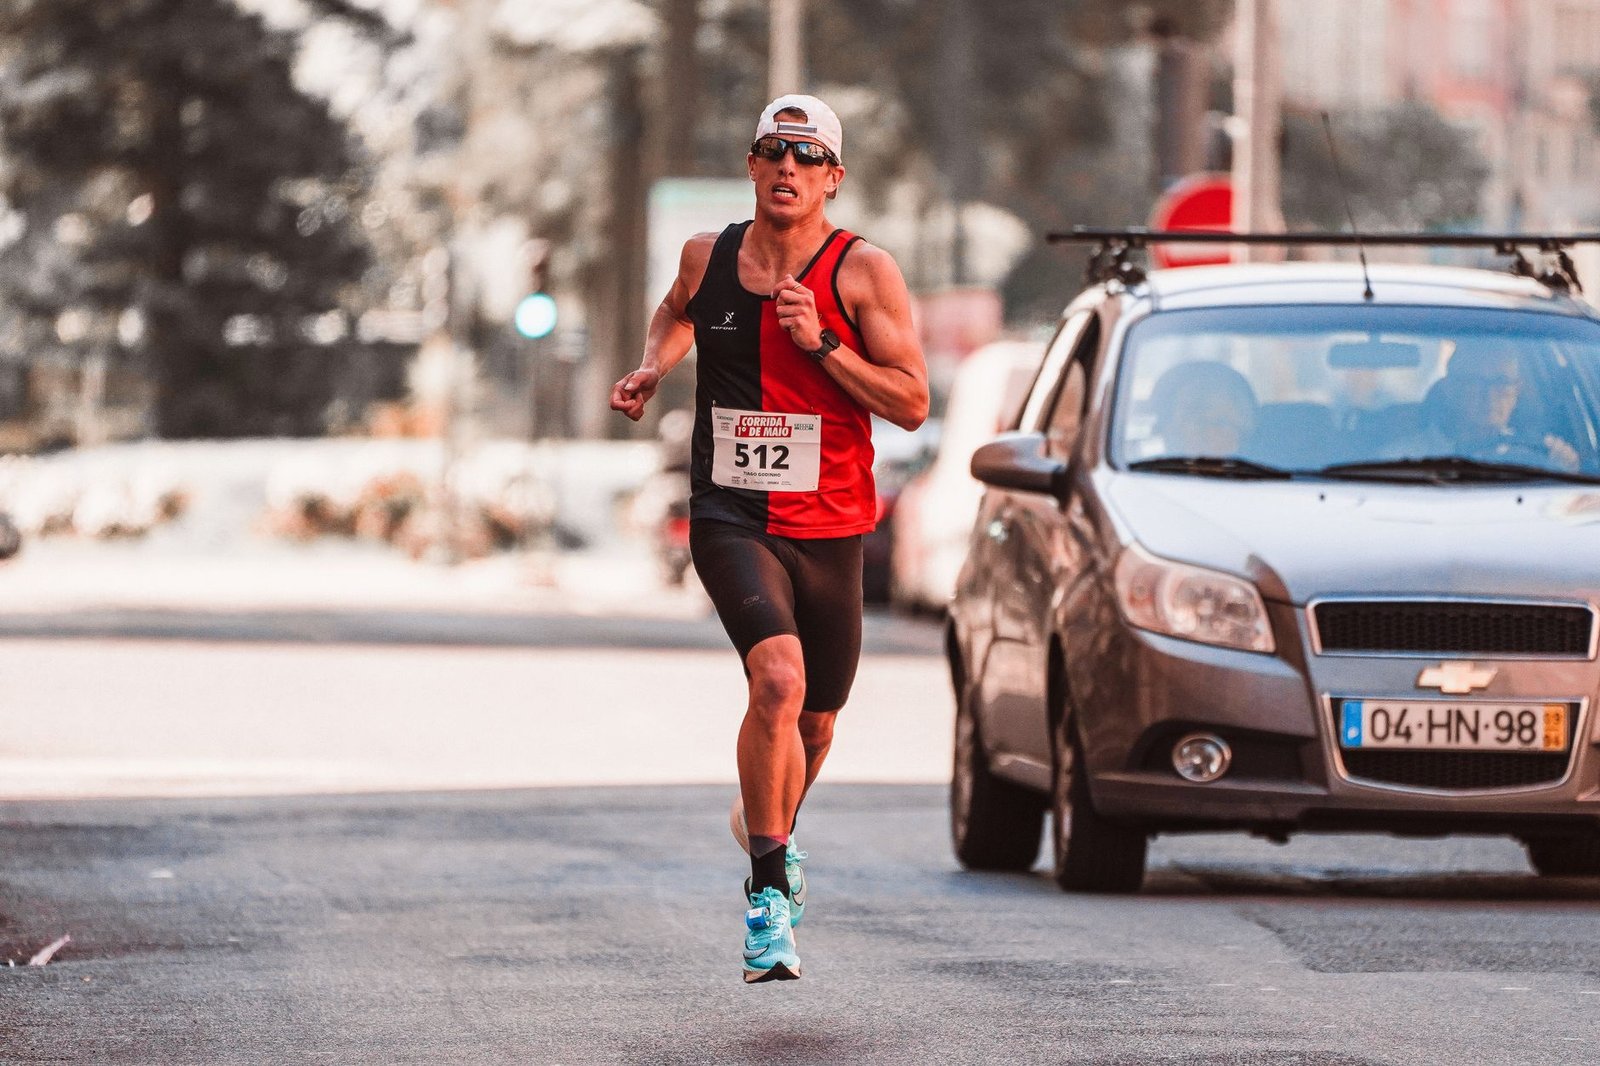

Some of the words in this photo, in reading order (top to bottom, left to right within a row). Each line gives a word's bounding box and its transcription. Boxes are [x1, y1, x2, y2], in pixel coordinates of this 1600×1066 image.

[741, 416, 783, 427] CORRIDA
[748, 427, 761, 437] DE
[763, 427, 789, 437] MAIO
[734, 442, 790, 470] 512
